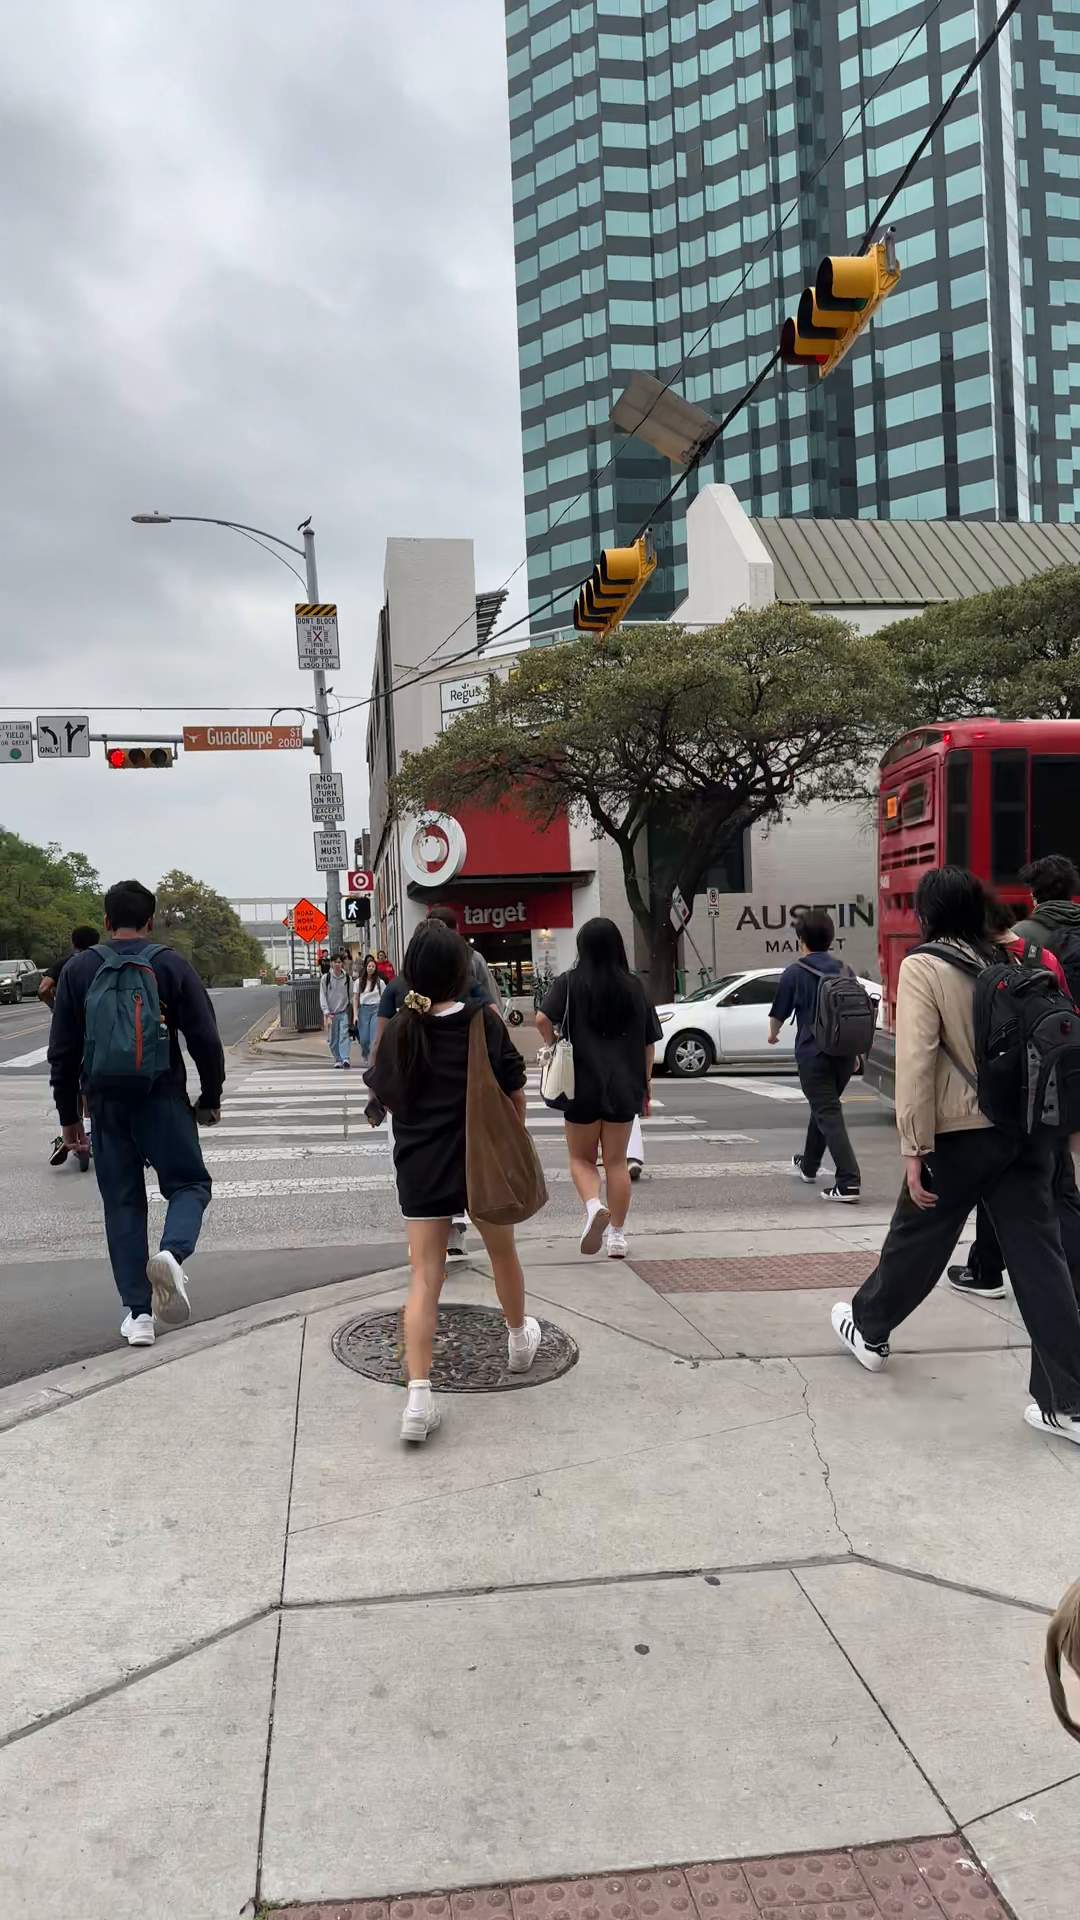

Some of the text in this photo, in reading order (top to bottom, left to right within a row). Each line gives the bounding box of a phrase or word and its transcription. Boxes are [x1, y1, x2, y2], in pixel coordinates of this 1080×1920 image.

[450, 687, 480, 704] Regus
[206, 728, 300, 748] Guadalupe ST
[278, 738, 300, 748] 2000
[464, 902, 526, 928] target
[766, 938, 846, 953] MAT
